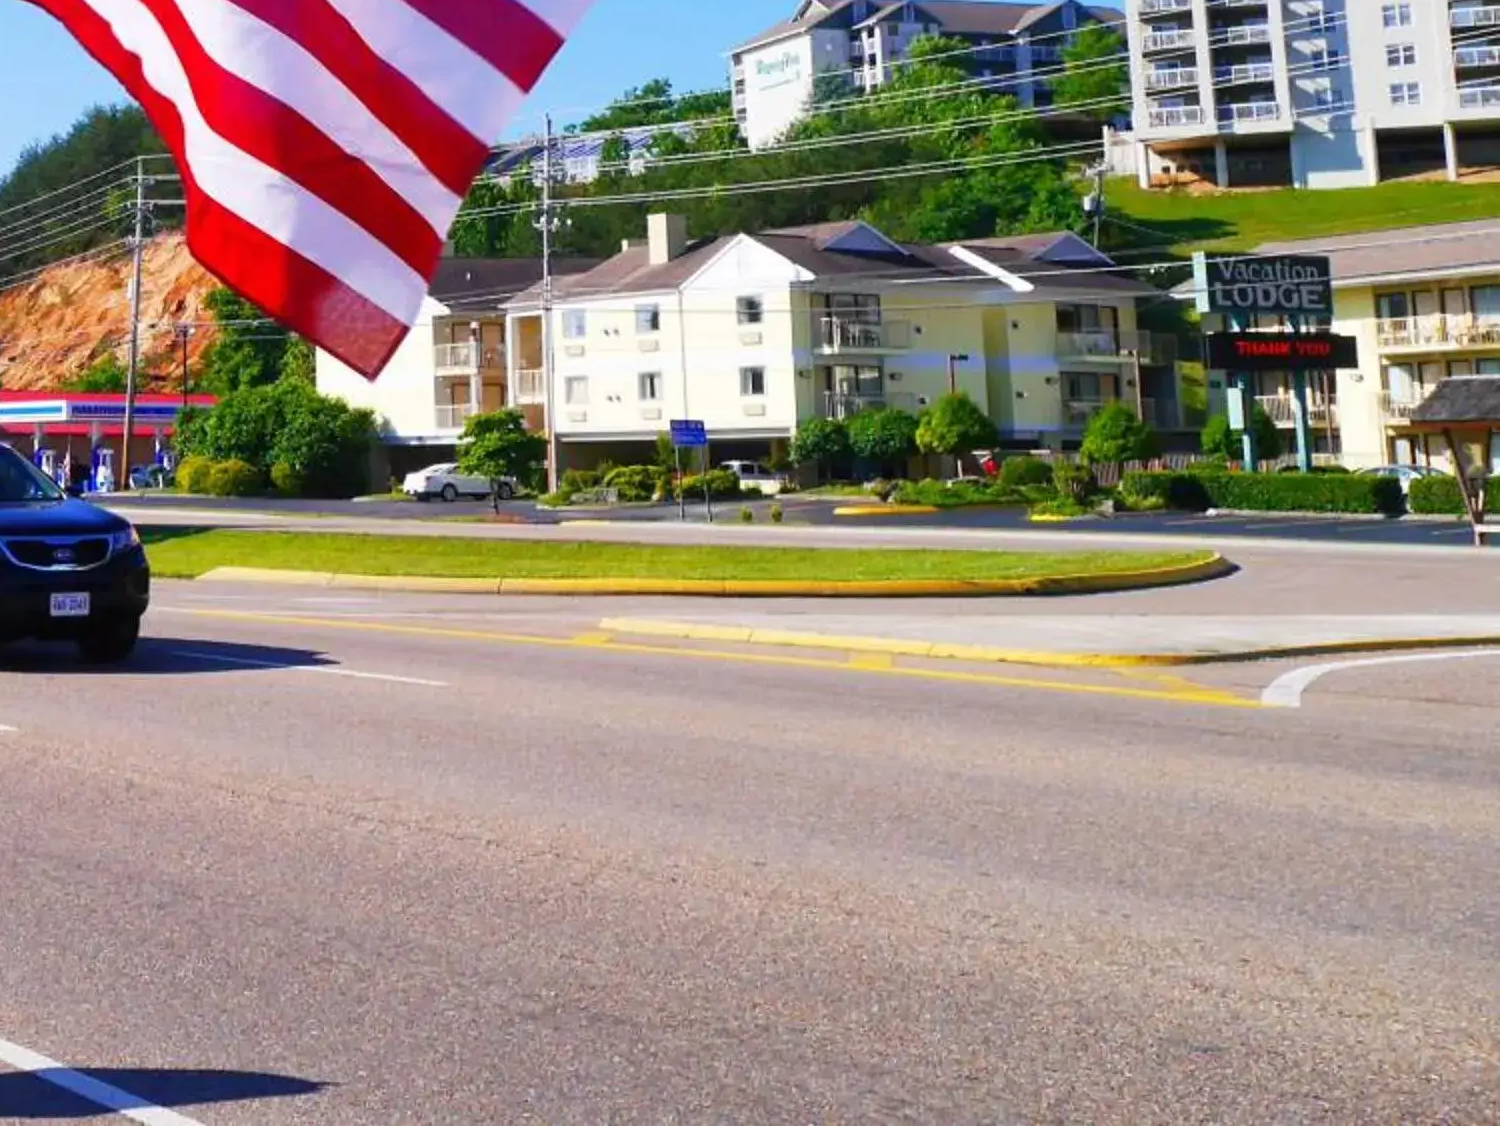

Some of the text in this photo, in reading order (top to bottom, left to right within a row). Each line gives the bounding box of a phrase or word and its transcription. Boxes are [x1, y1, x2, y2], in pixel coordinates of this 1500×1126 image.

[1218, 257, 1319, 283] Vacation
[1213, 282, 1327, 309] LODGE
[1236, 340, 1331, 356] THANK YOU
